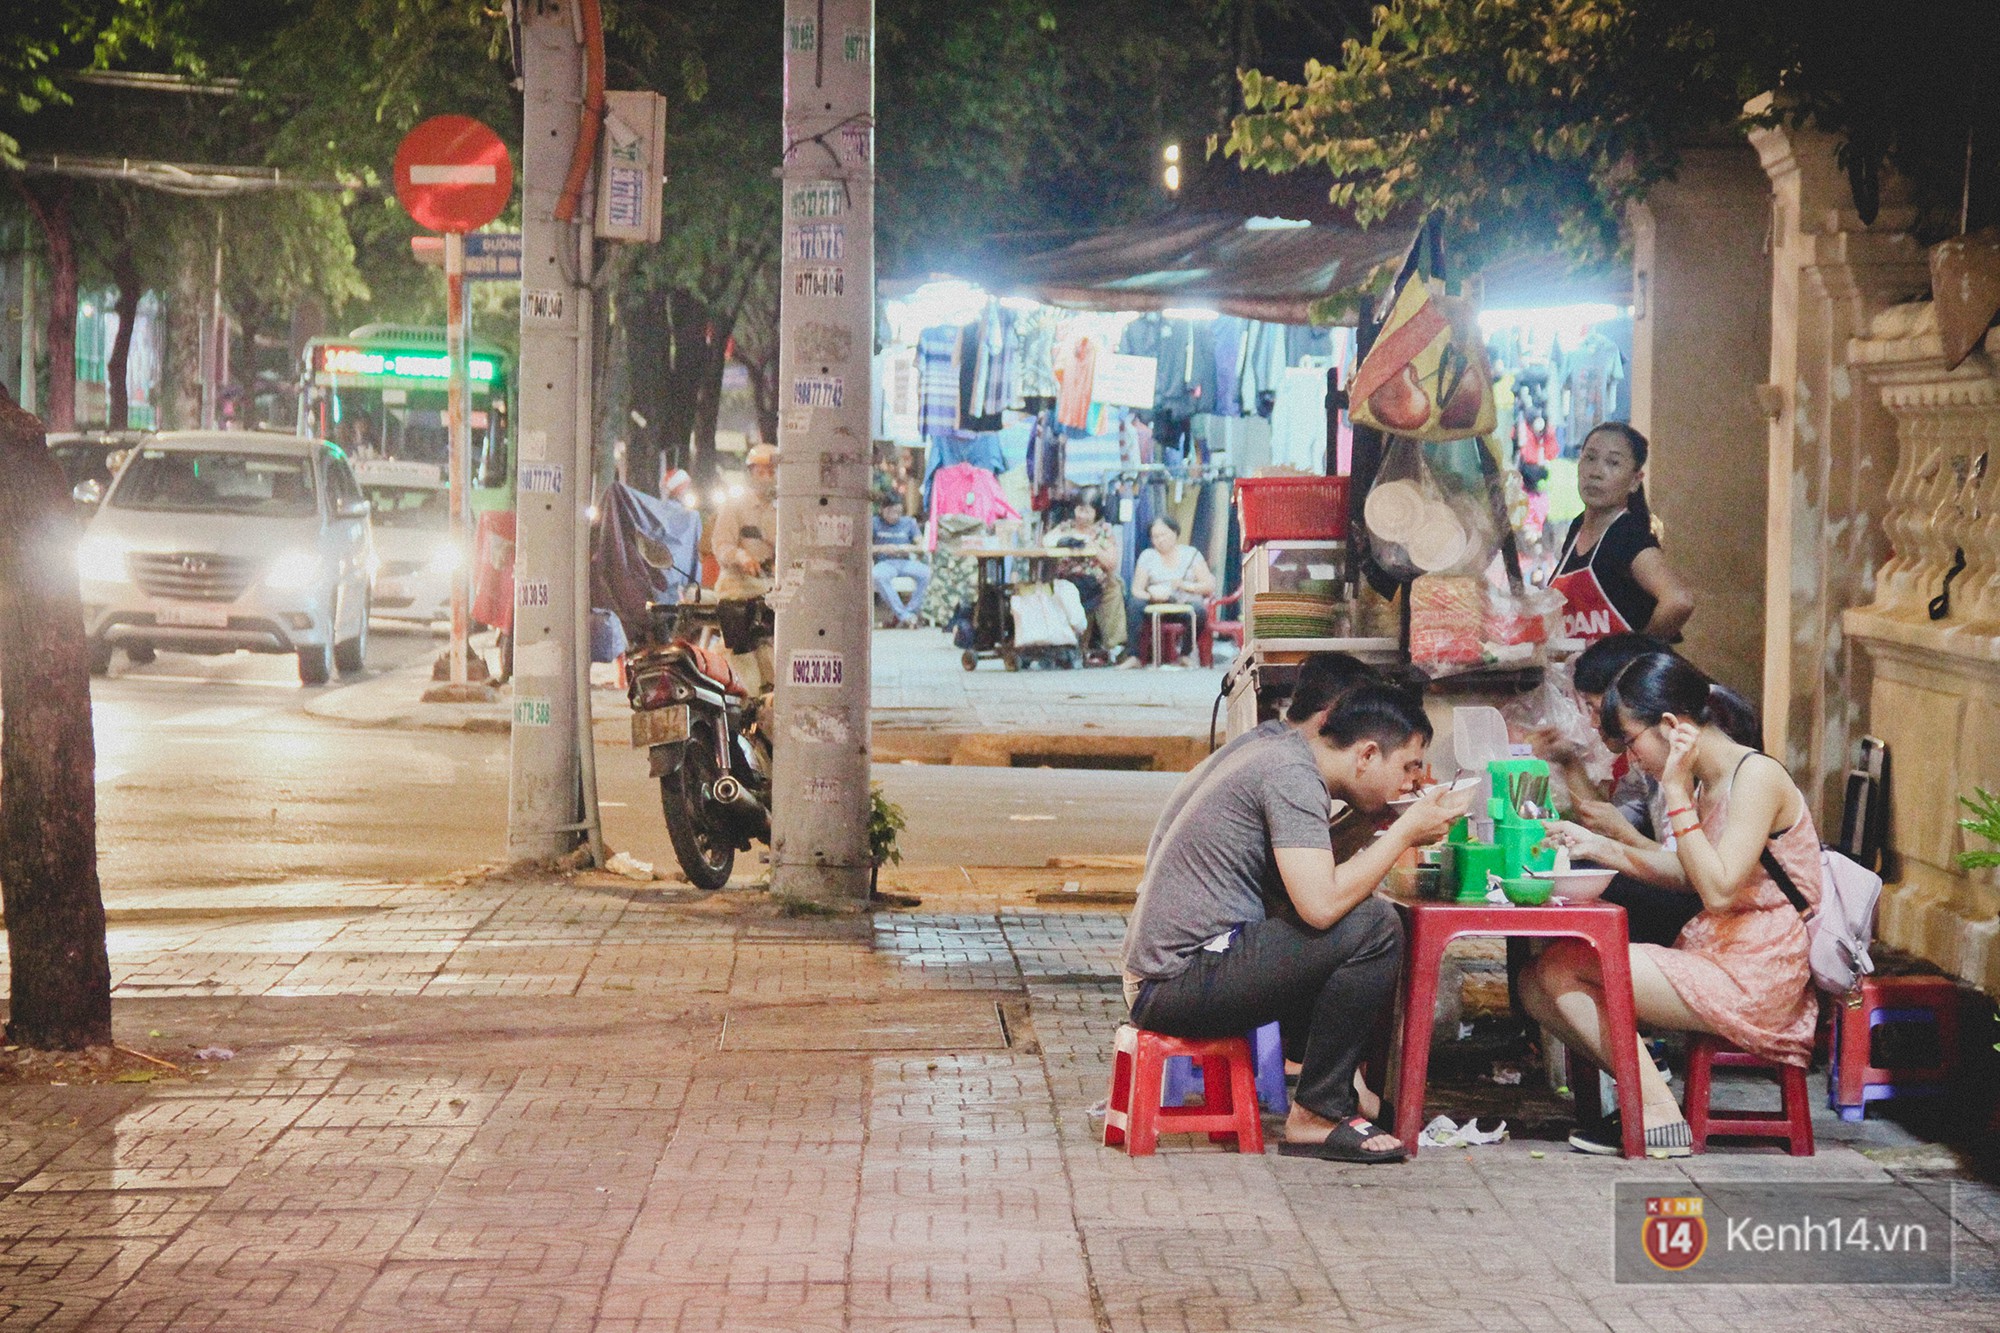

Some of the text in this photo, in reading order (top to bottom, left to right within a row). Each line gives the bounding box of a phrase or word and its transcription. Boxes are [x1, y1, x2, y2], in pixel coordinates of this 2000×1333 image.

[793, 660, 842, 684] 0902 30 30 58
